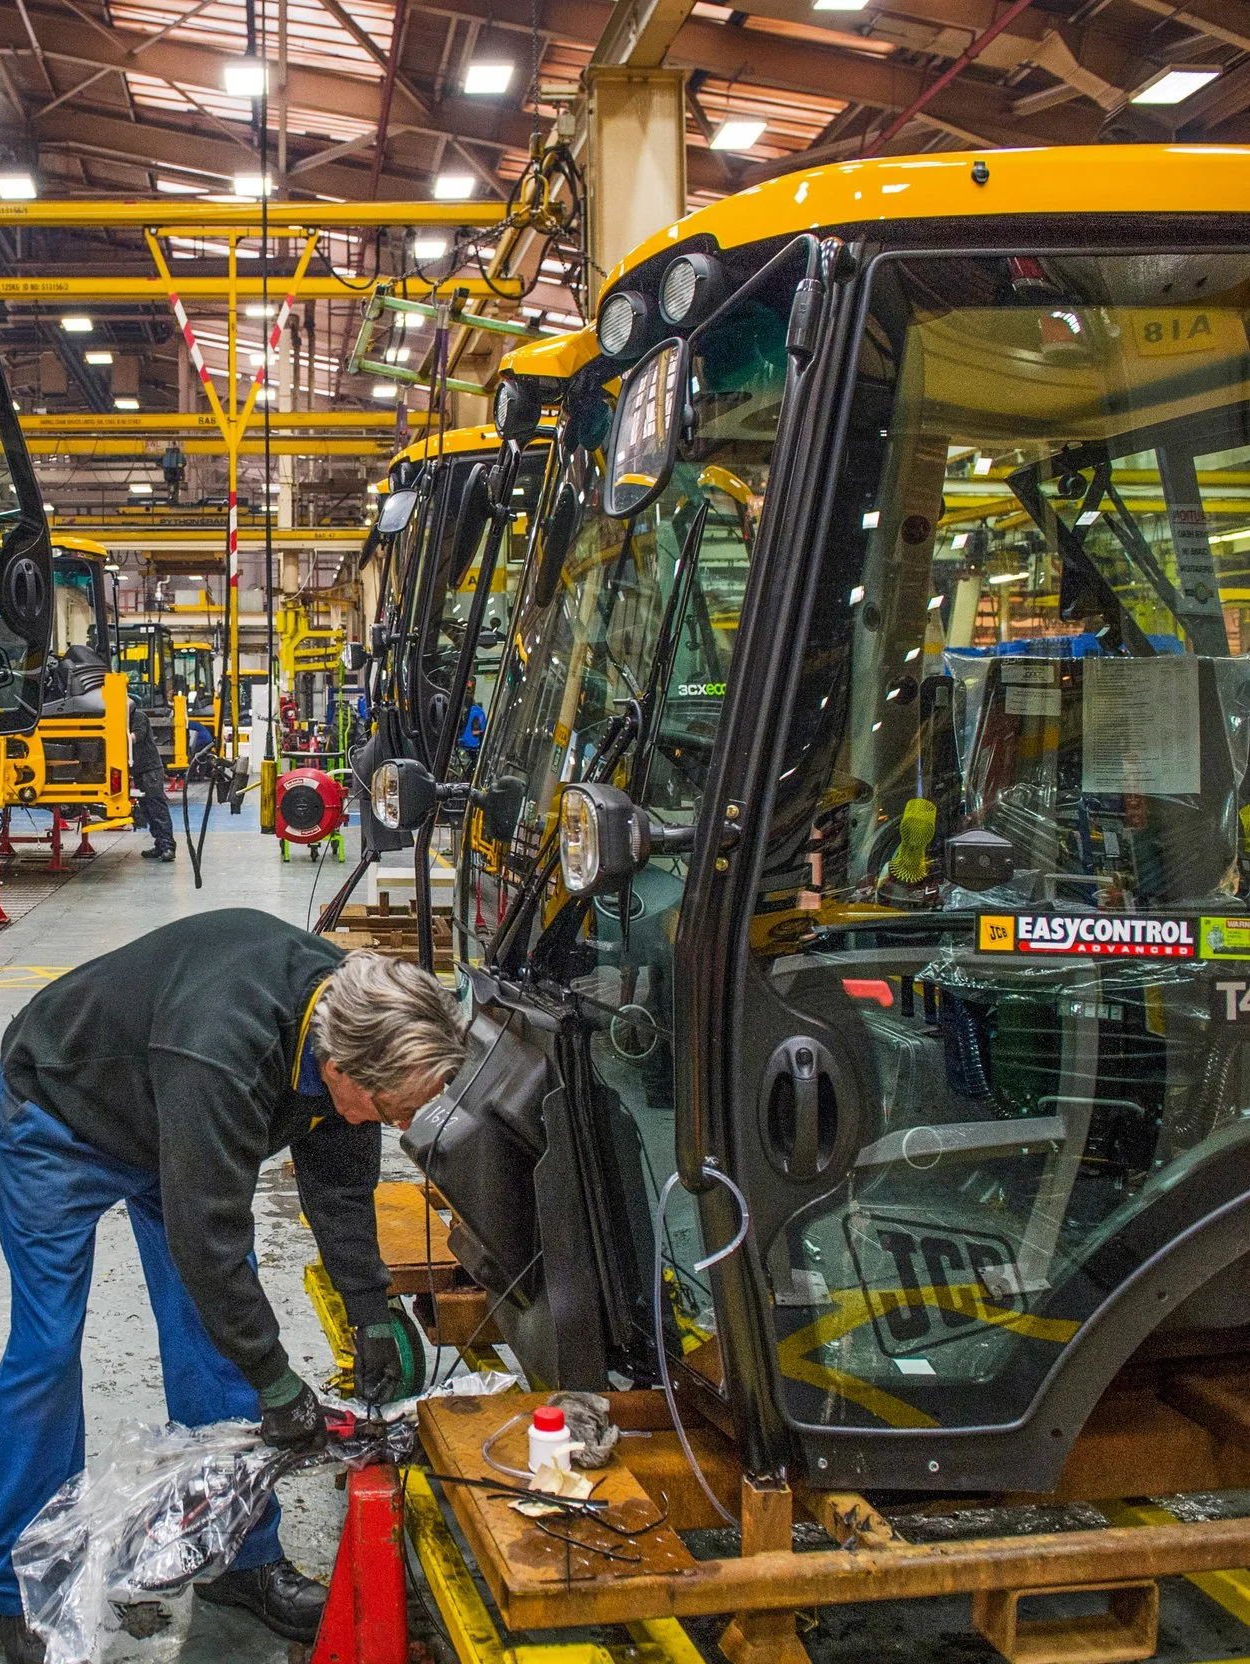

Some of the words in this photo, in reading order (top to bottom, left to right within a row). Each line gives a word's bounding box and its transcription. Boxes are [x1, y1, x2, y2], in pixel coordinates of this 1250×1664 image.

[990, 926, 1008, 940] JCB
[1018, 916, 1194, 948] EASYCONTROL
[1227, 920, 1250, 928] WARN
[1078, 943, 1189, 955] ADVANCED
[876, 1229, 1018, 1342] JCB
